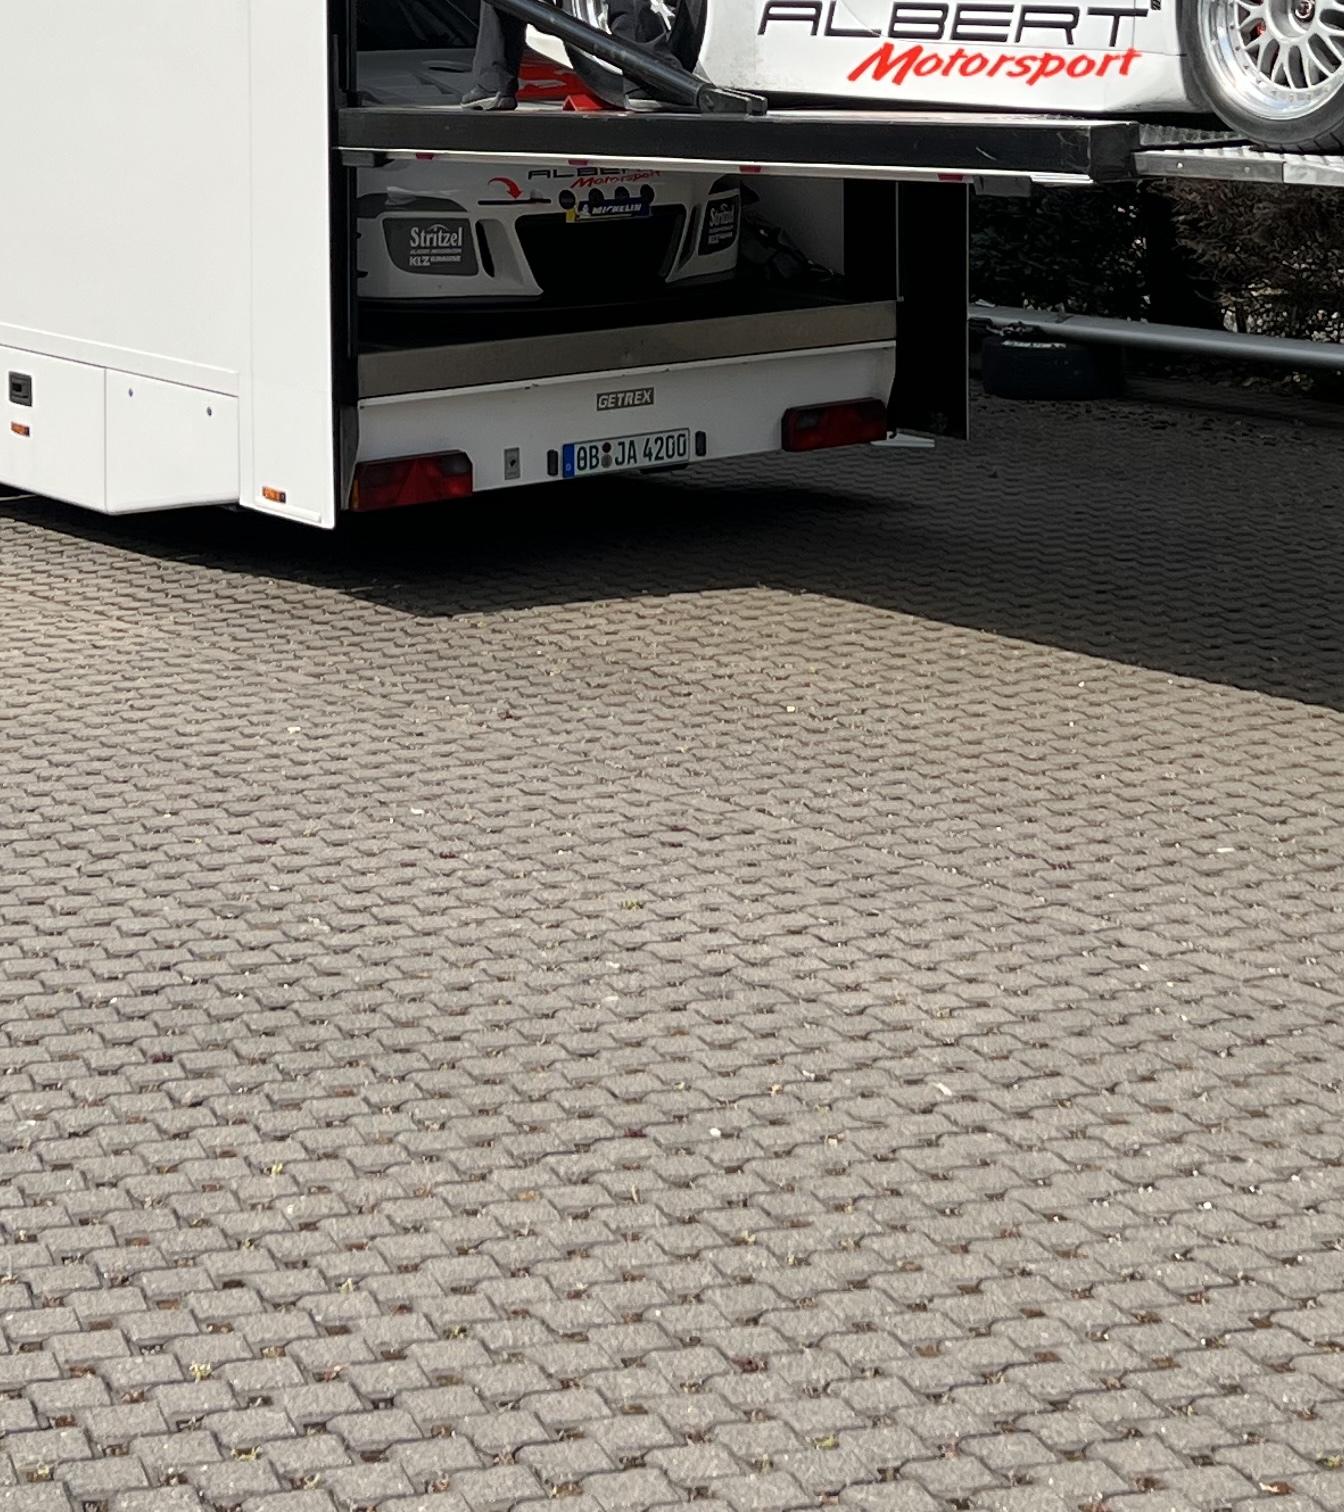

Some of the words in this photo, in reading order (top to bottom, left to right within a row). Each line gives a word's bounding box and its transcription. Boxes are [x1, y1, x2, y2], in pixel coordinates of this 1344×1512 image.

[757, 0, 1149, 48] ALBERT
[847, 41, 1142, 86] Motorsport
[591, 204, 642, 214] MICHELIN
[409, 226, 463, 247] Stritzel
[598, 389, 652, 409] GETREX
[614, 440, 638, 466] JA
[643, 433, 687, 462] 4200
